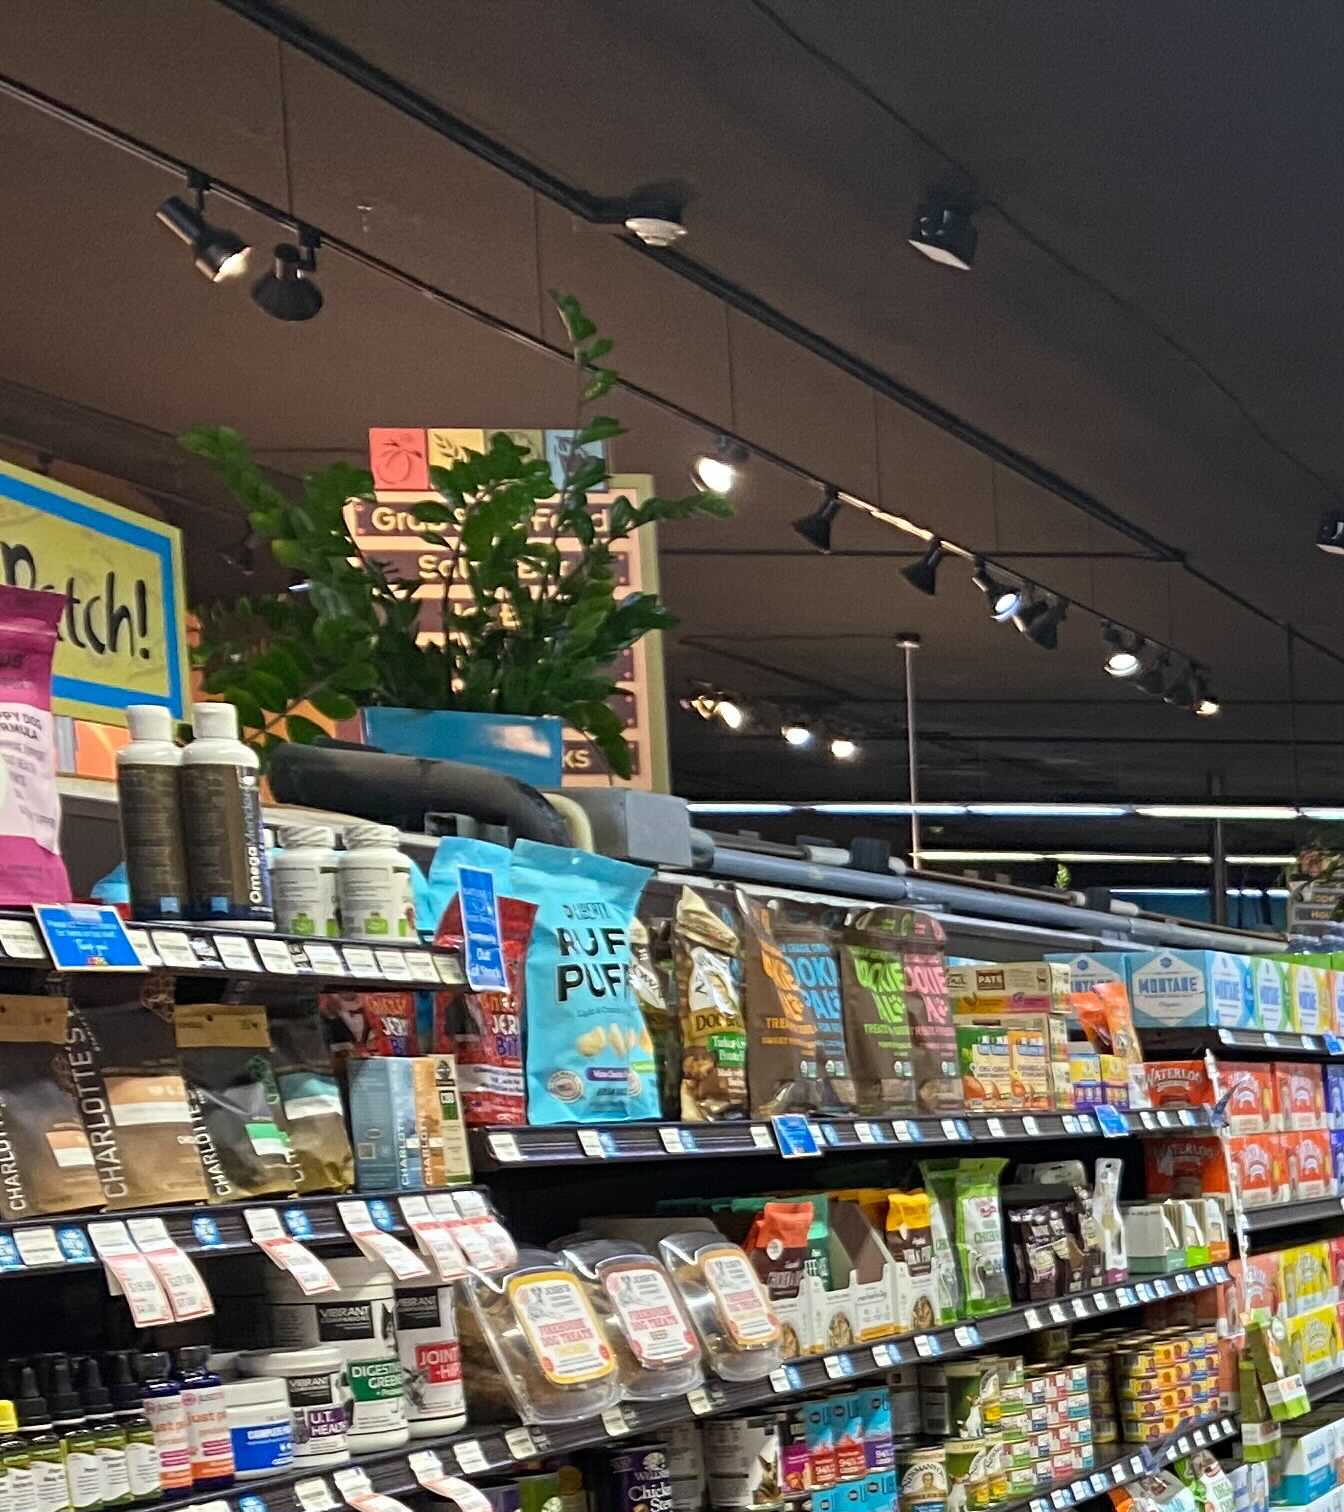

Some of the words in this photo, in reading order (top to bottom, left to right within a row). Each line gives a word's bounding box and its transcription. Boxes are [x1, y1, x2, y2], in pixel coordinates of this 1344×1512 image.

[250, 846, 264, 903] Omega
[1139, 975, 1199, 994] MONTANE
[65, 1026, 129, 1199] CHARLOTTE'S
[319, 1305, 370, 1319] VIBRANT
